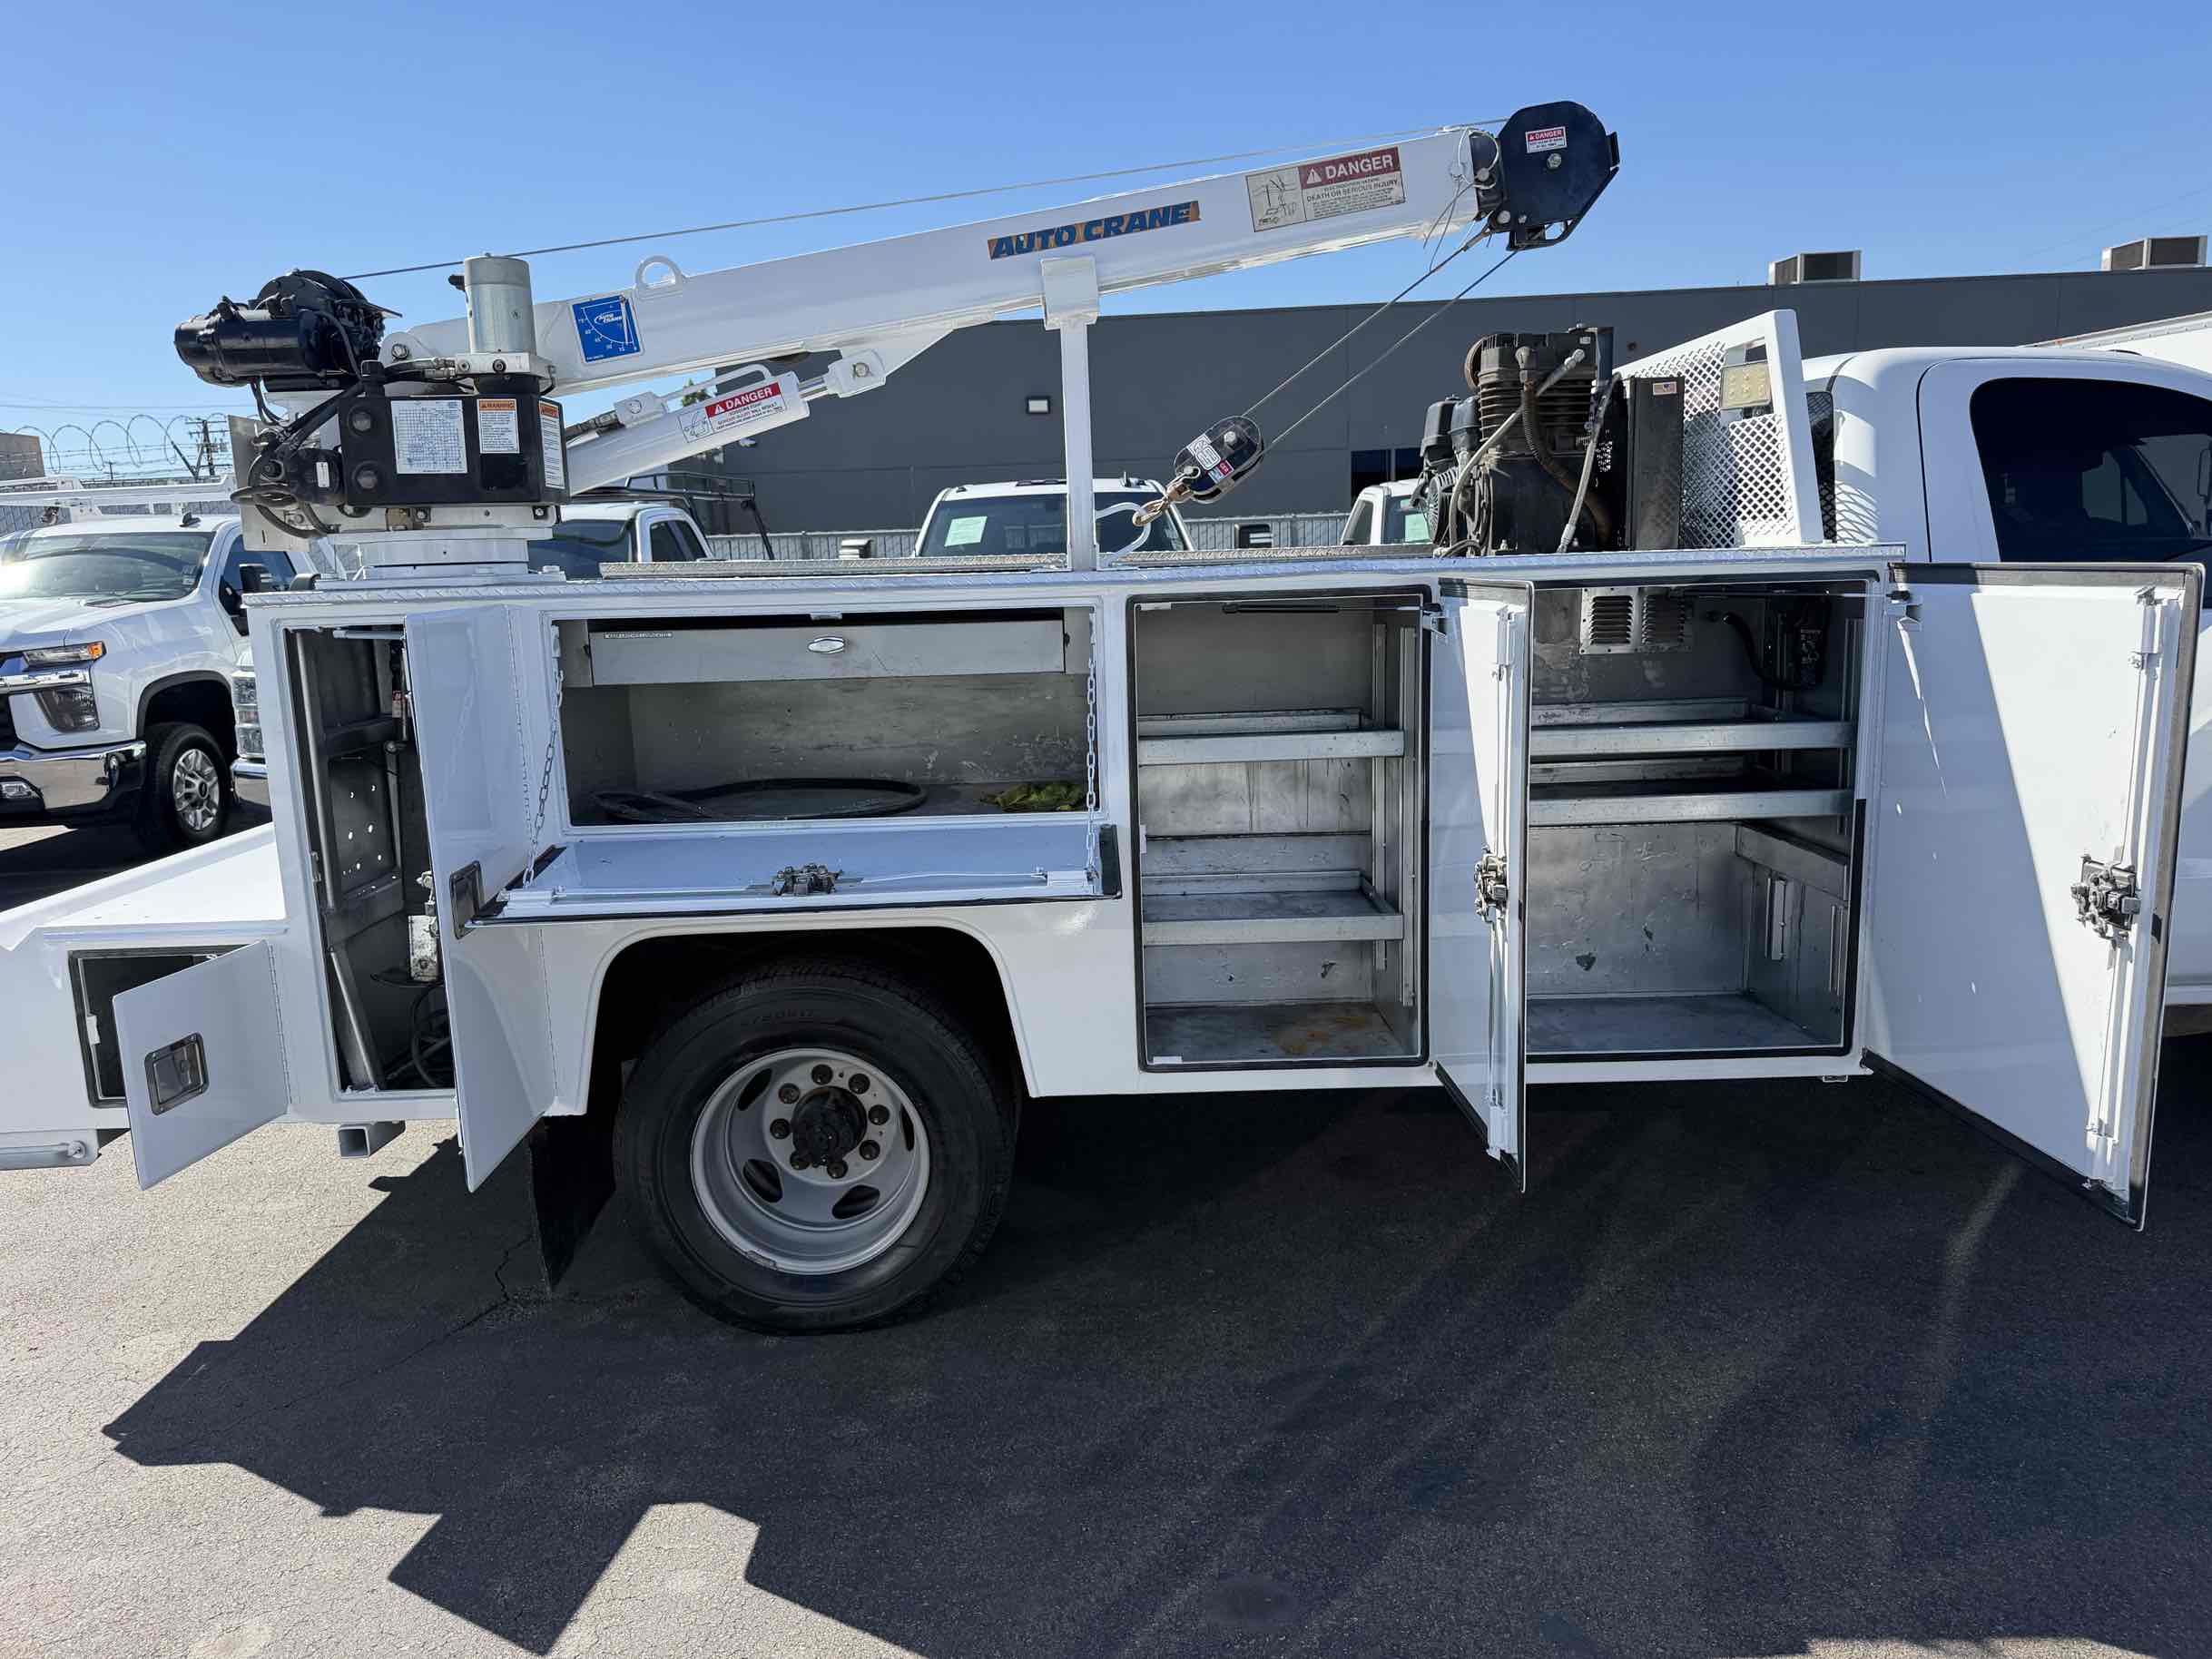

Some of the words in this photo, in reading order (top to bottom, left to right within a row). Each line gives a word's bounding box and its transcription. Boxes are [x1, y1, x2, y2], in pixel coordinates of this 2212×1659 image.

[1325, 154, 1393, 179] DANGER
[991, 225, 1077, 260] AUTO
[1084, 201, 1192, 241] CRANE
[726, 388, 772, 409] DANGER
